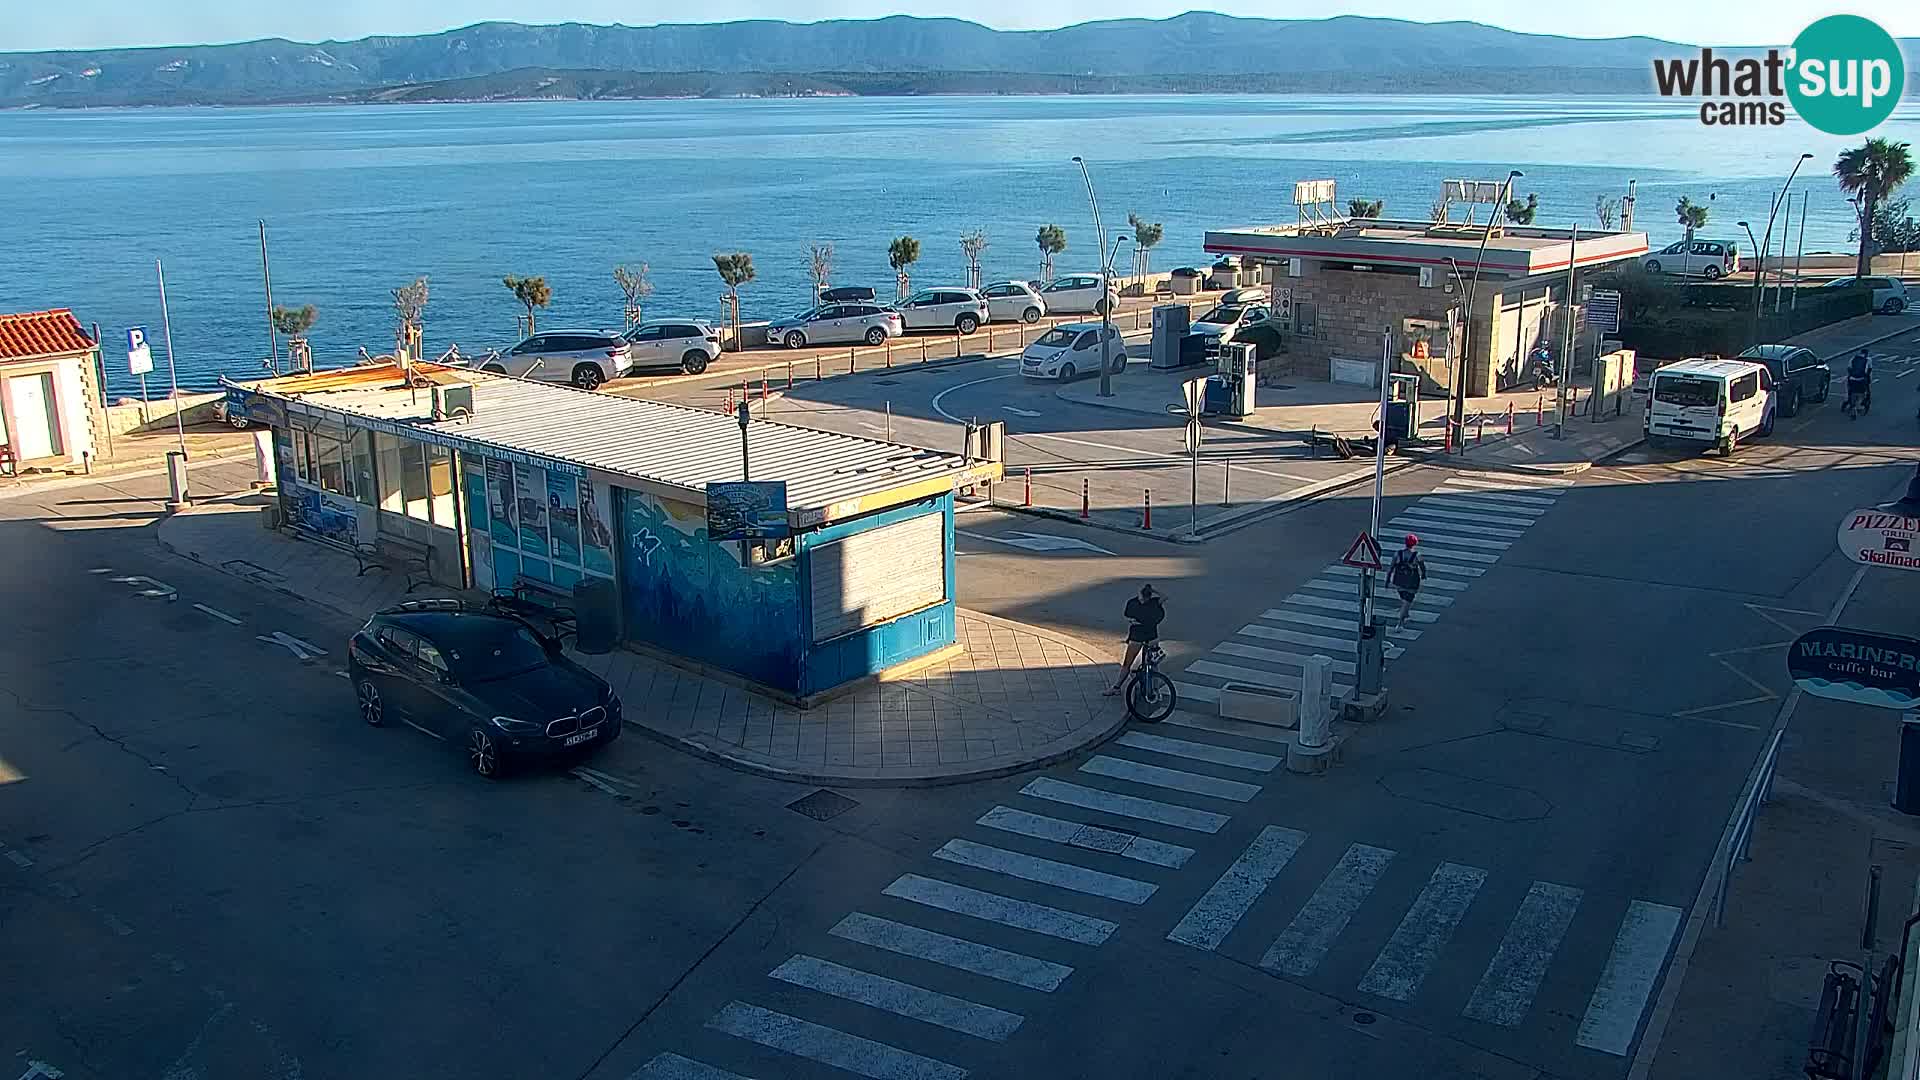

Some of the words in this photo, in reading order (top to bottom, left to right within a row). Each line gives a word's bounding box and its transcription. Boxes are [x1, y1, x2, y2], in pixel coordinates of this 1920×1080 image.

[130, 330, 144, 349] P
[437, 436, 468, 450] POSTAJA
[479, 445, 493, 456] BUS
[495, 450, 527, 464] STATION
[529, 456, 555, 470] TICKET
[556, 462, 582, 476] OFFICE
[1847, 514, 1920, 532] PIZZE
[1880, 529, 1917, 540] GRILL
[1827, 660, 1866, 675] caffe
[1869, 663, 1897, 680] bar
